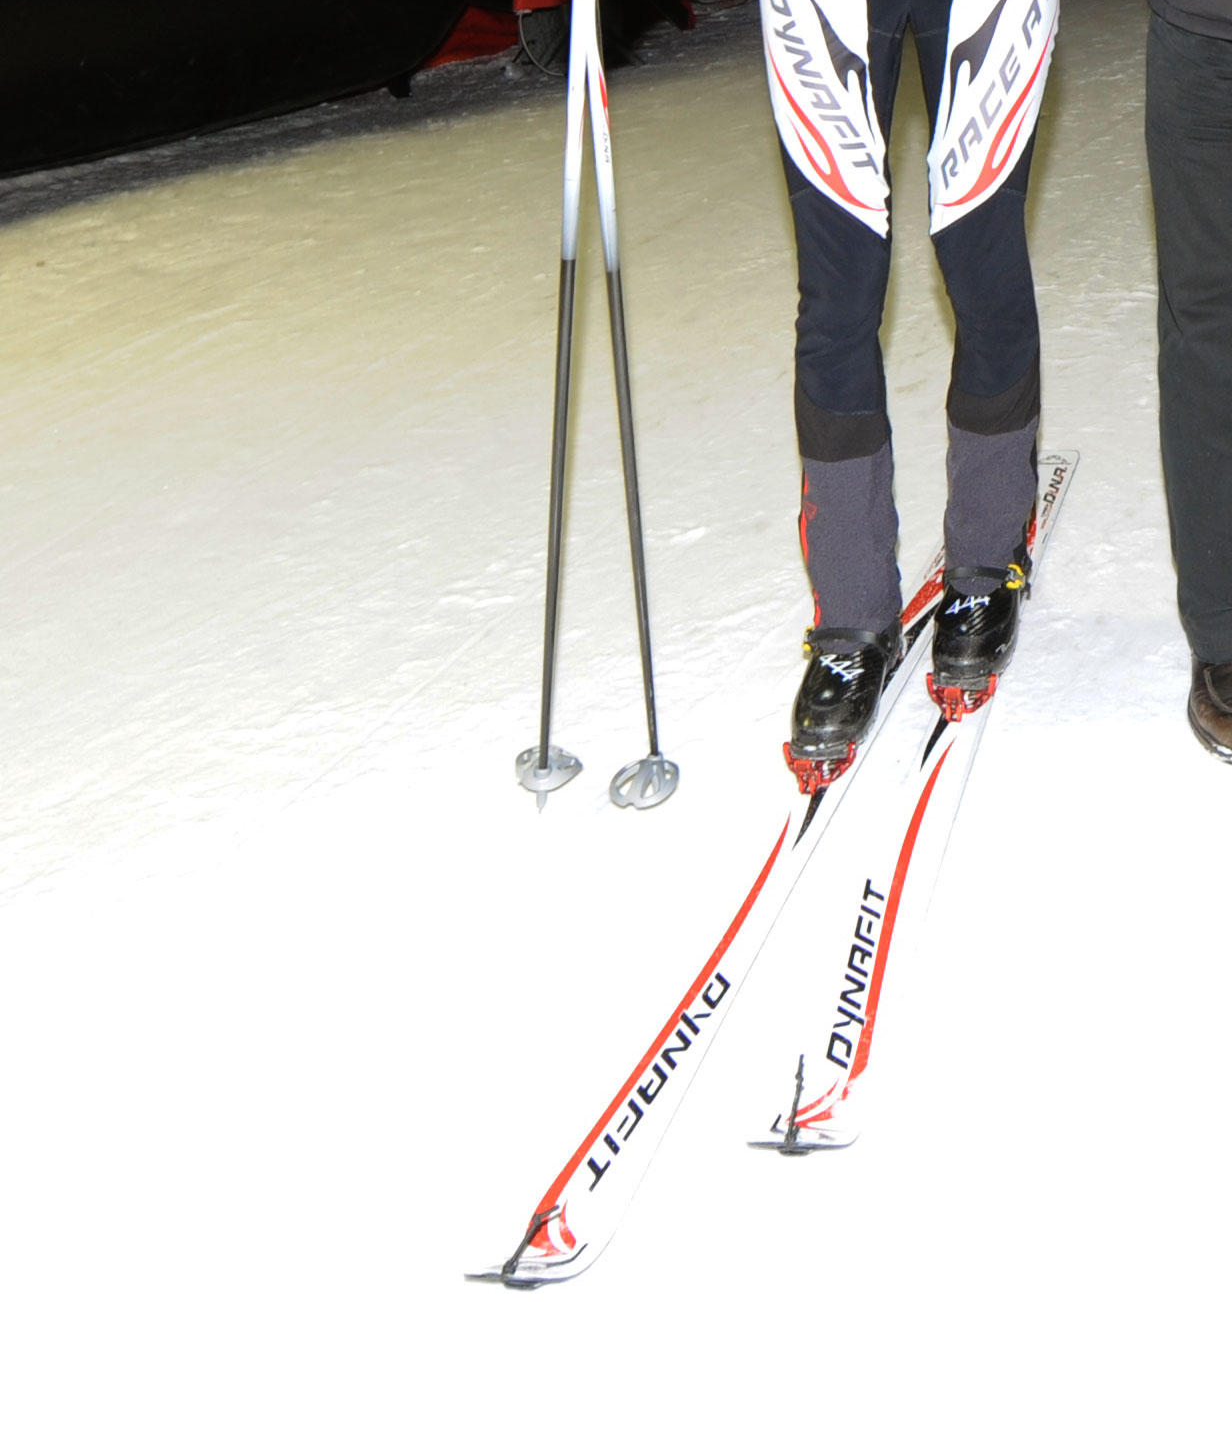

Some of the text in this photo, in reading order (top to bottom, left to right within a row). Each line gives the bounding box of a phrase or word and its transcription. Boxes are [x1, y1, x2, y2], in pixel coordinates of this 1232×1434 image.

[941, 42, 1022, 190] RACE
[819, 653, 866, 683] 444
[826, 878, 885, 1070] DYNAFIT
[586, 971, 731, 1192] DYNAFIT
